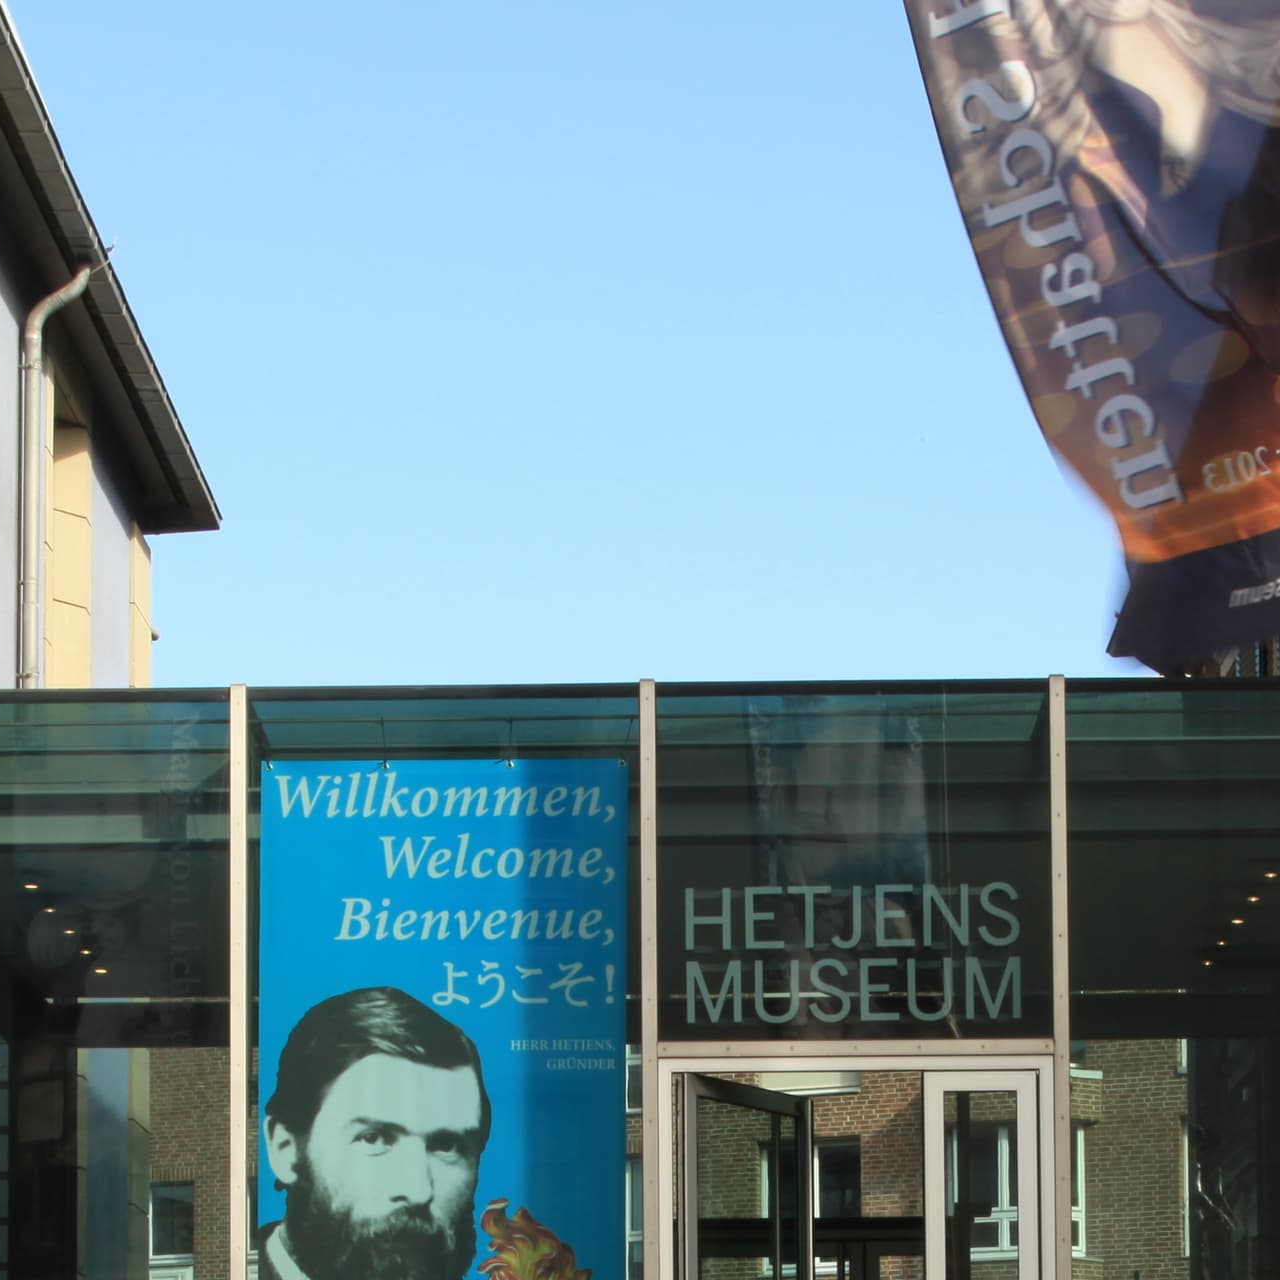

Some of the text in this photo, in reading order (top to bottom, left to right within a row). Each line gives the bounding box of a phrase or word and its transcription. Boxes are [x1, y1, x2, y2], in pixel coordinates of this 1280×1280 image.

[275, 771, 617, 823] Willkommen,
[379, 833, 616, 884] Welcome,
[334, 898, 616, 946] Bienvenue,
[685, 881, 1021, 950] HETJENS
[685, 955, 1022, 1024] MUSEUM
[510, 1039, 549, 1051] HERR
[546, 1056, 616, 1070] GRÜNDER
